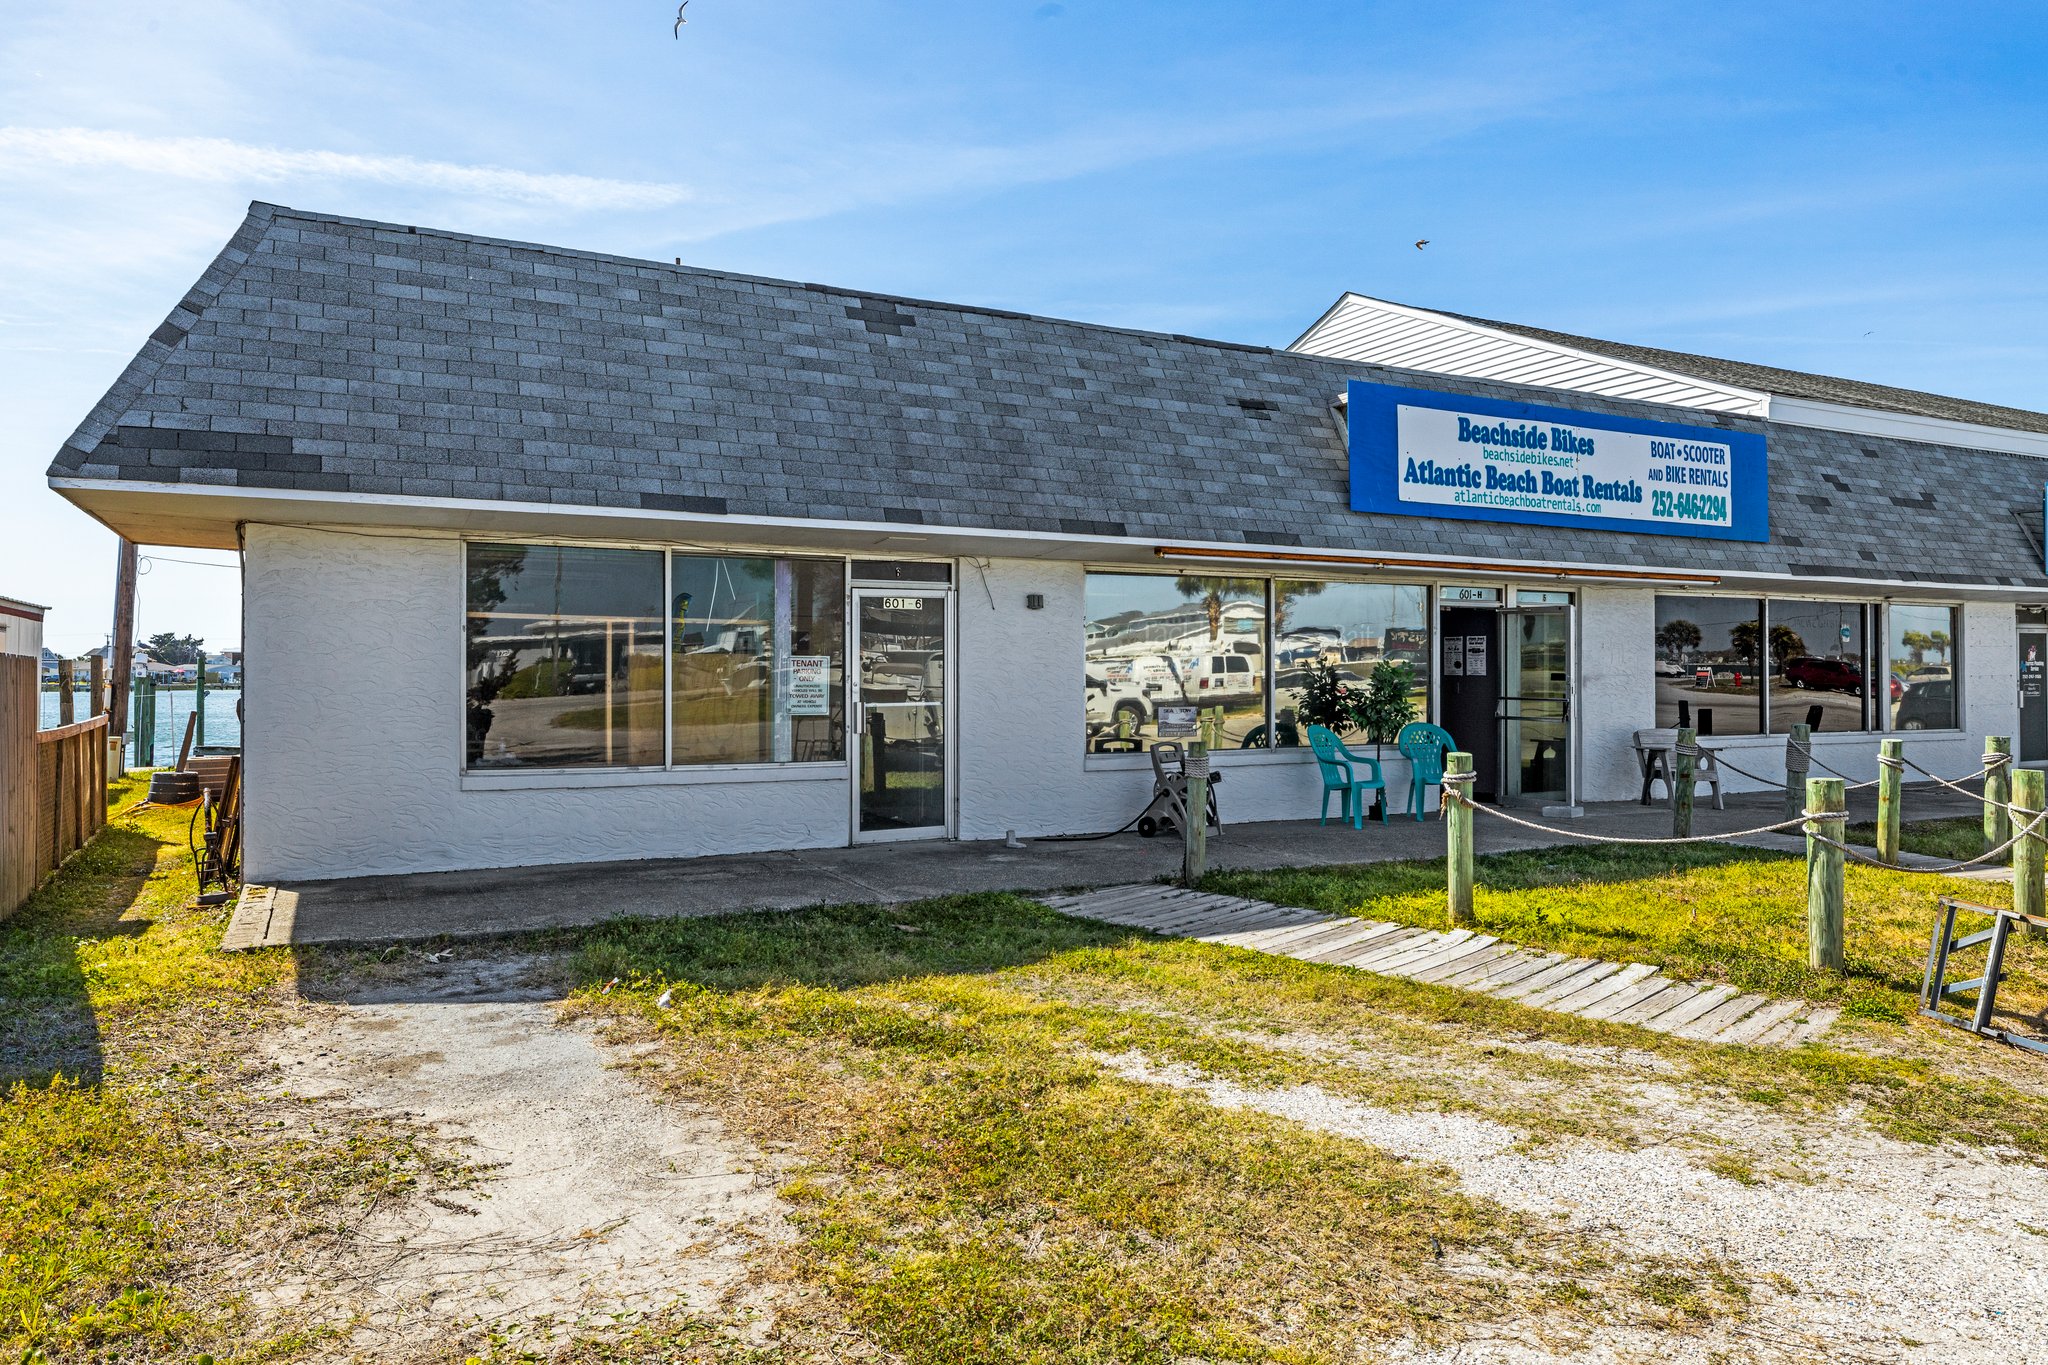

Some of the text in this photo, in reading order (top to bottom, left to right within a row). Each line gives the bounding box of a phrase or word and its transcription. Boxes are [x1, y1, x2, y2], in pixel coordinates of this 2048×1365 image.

[1457, 416, 1595, 457] Beachside Bikes
[1482, 446, 1574, 468] beachsidebikes.net
[1403, 456, 1643, 504] Atlantic Beach Boat Rentals
[1648, 465, 1729, 489] AND BIKE RENTALS
[1454, 489, 1602, 514] atlanticbeachboatrentals.com
[1651, 489, 1728, 522] 252-646-2294
[884, 598, 922, 609] 601-6
[1459, 588, 1483, 600] 601-H
[791, 659, 824, 668] TENANT
